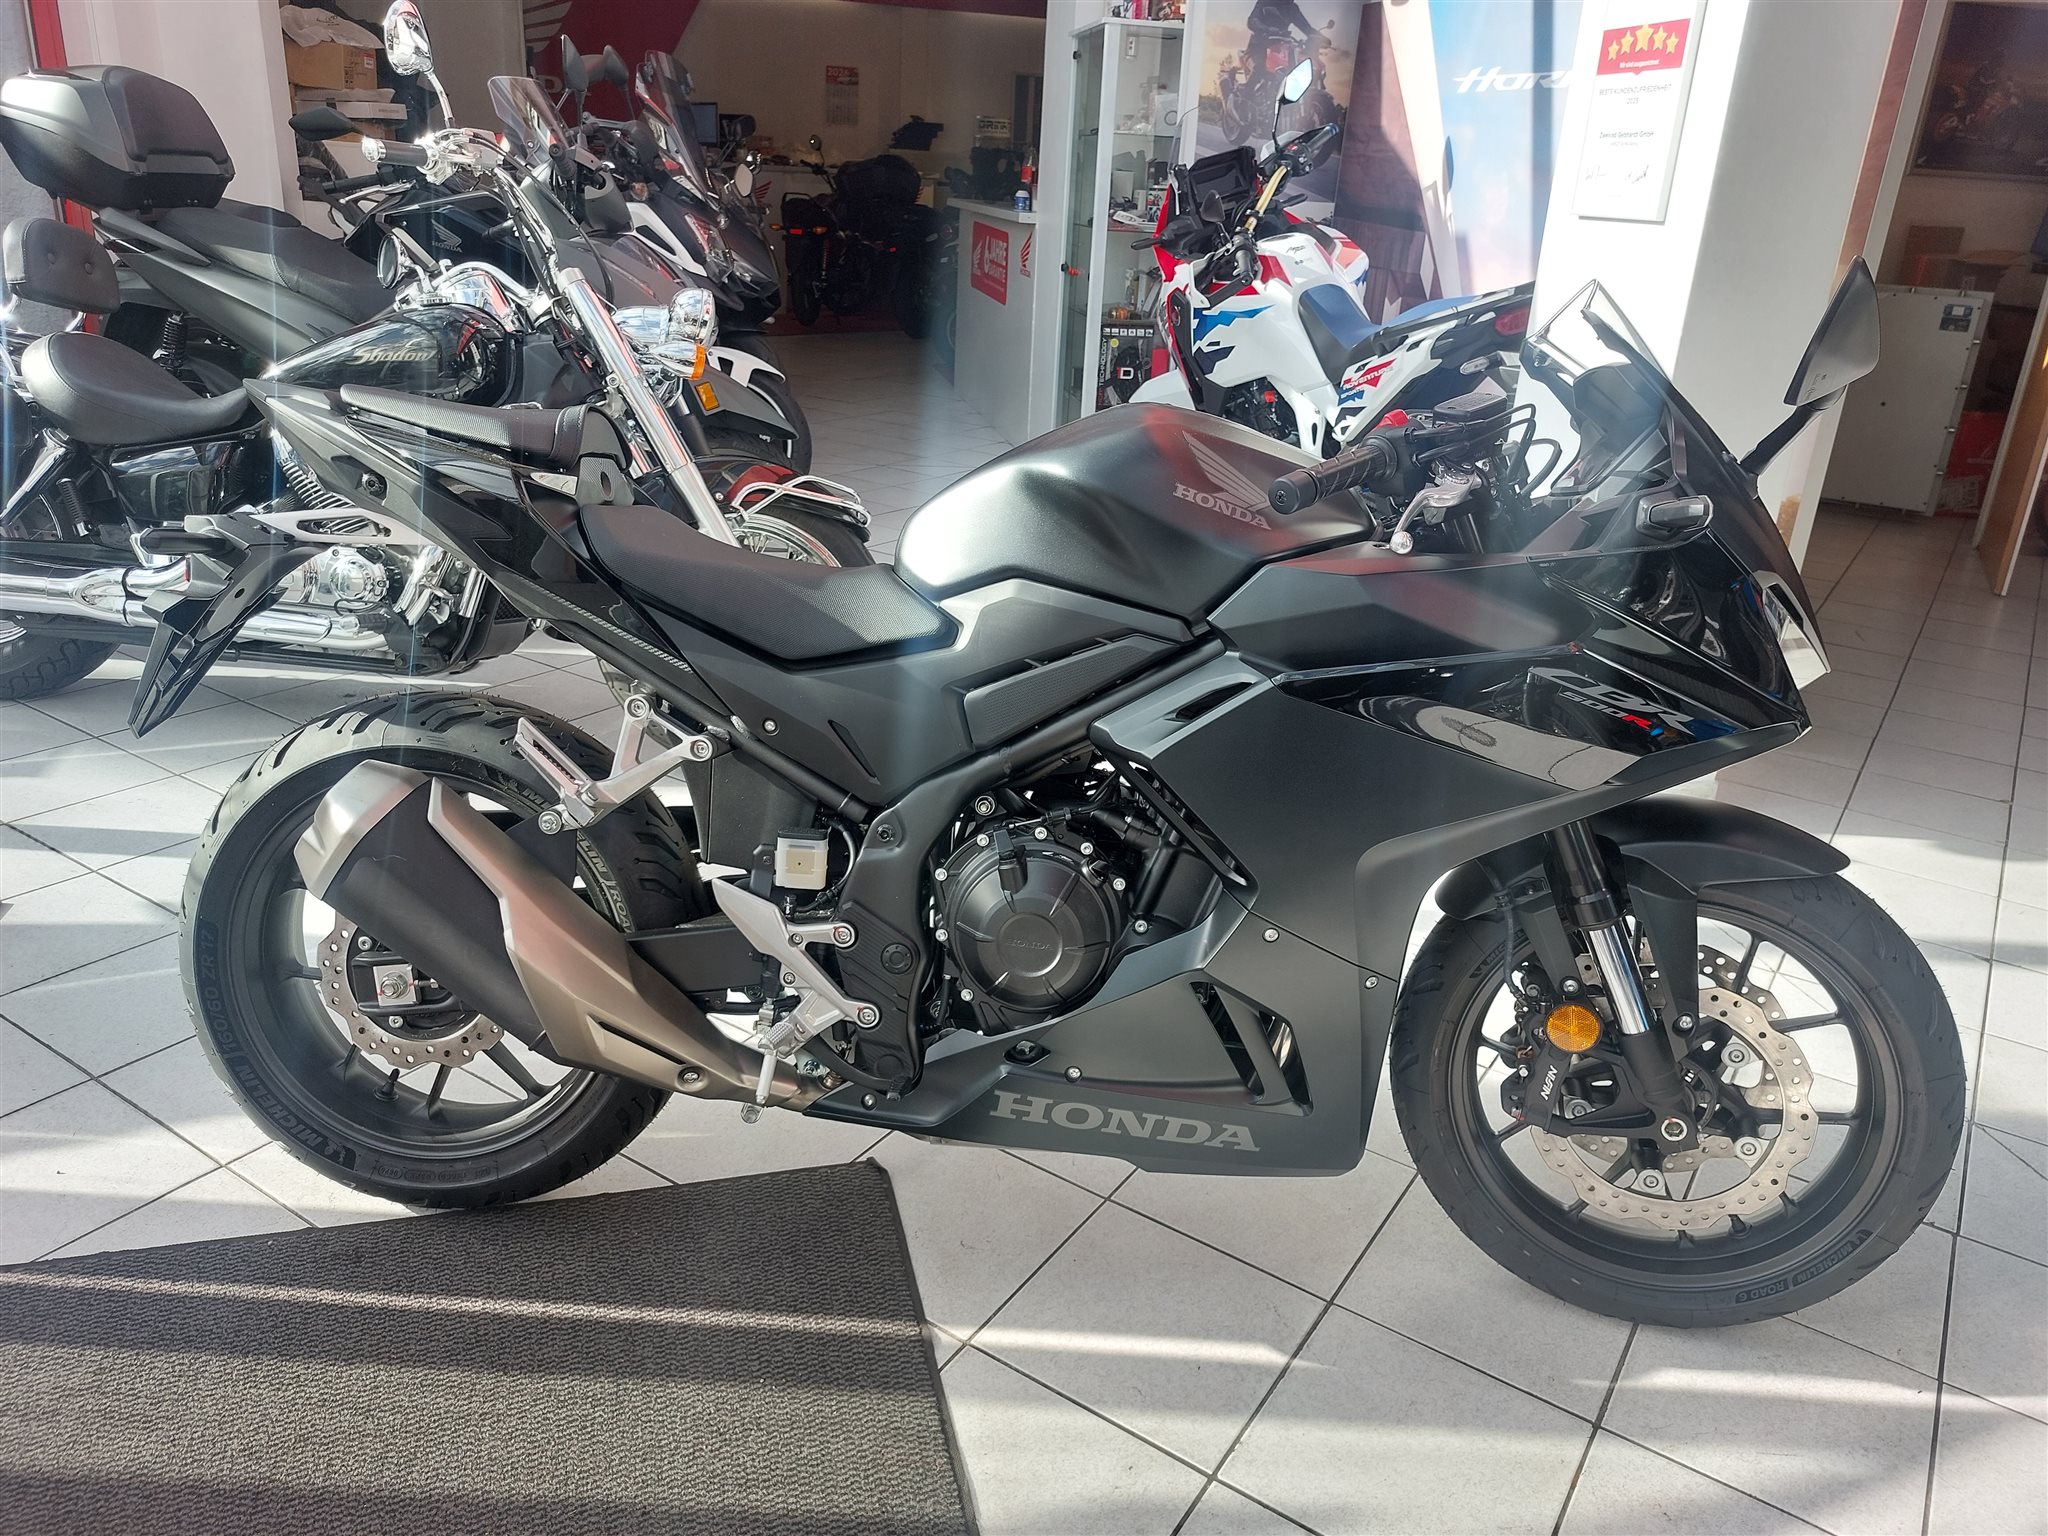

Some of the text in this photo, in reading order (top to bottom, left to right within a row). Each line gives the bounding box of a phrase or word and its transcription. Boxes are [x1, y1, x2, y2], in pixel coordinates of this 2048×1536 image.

[1098, 337, 1108, 386] TECHNOLOGY
[1172, 481, 1272, 531] HONDA
[1558, 691, 1652, 730] 500R
[235, 1064, 324, 1148] MICHELIN
[989, 1089, 1260, 1152] HONDA
[1750, 1279, 1787, 1299] ROAD
